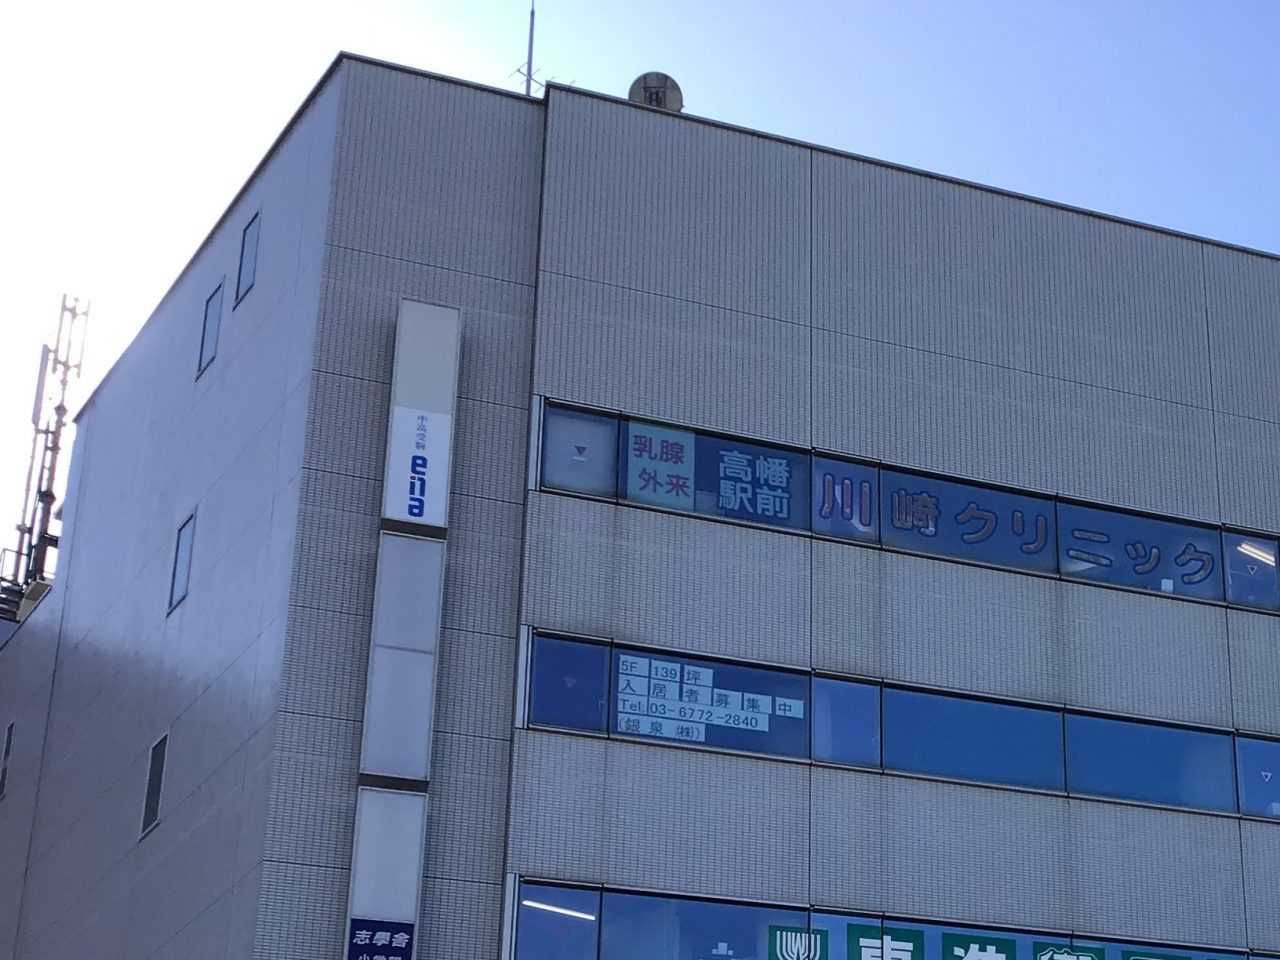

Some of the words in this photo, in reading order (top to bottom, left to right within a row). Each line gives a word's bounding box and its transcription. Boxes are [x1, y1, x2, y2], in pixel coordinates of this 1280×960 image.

[633, 435, 685, 465] 乳腺
[719, 450, 790, 488] 高幡
[408, 454, 428, 518] ena
[638, 467, 691, 498] 外来
[718, 480, 790, 519] 駅前
[820, 472, 1216, 586] 川崎クリニック
[620, 660, 639, 673] 5F
